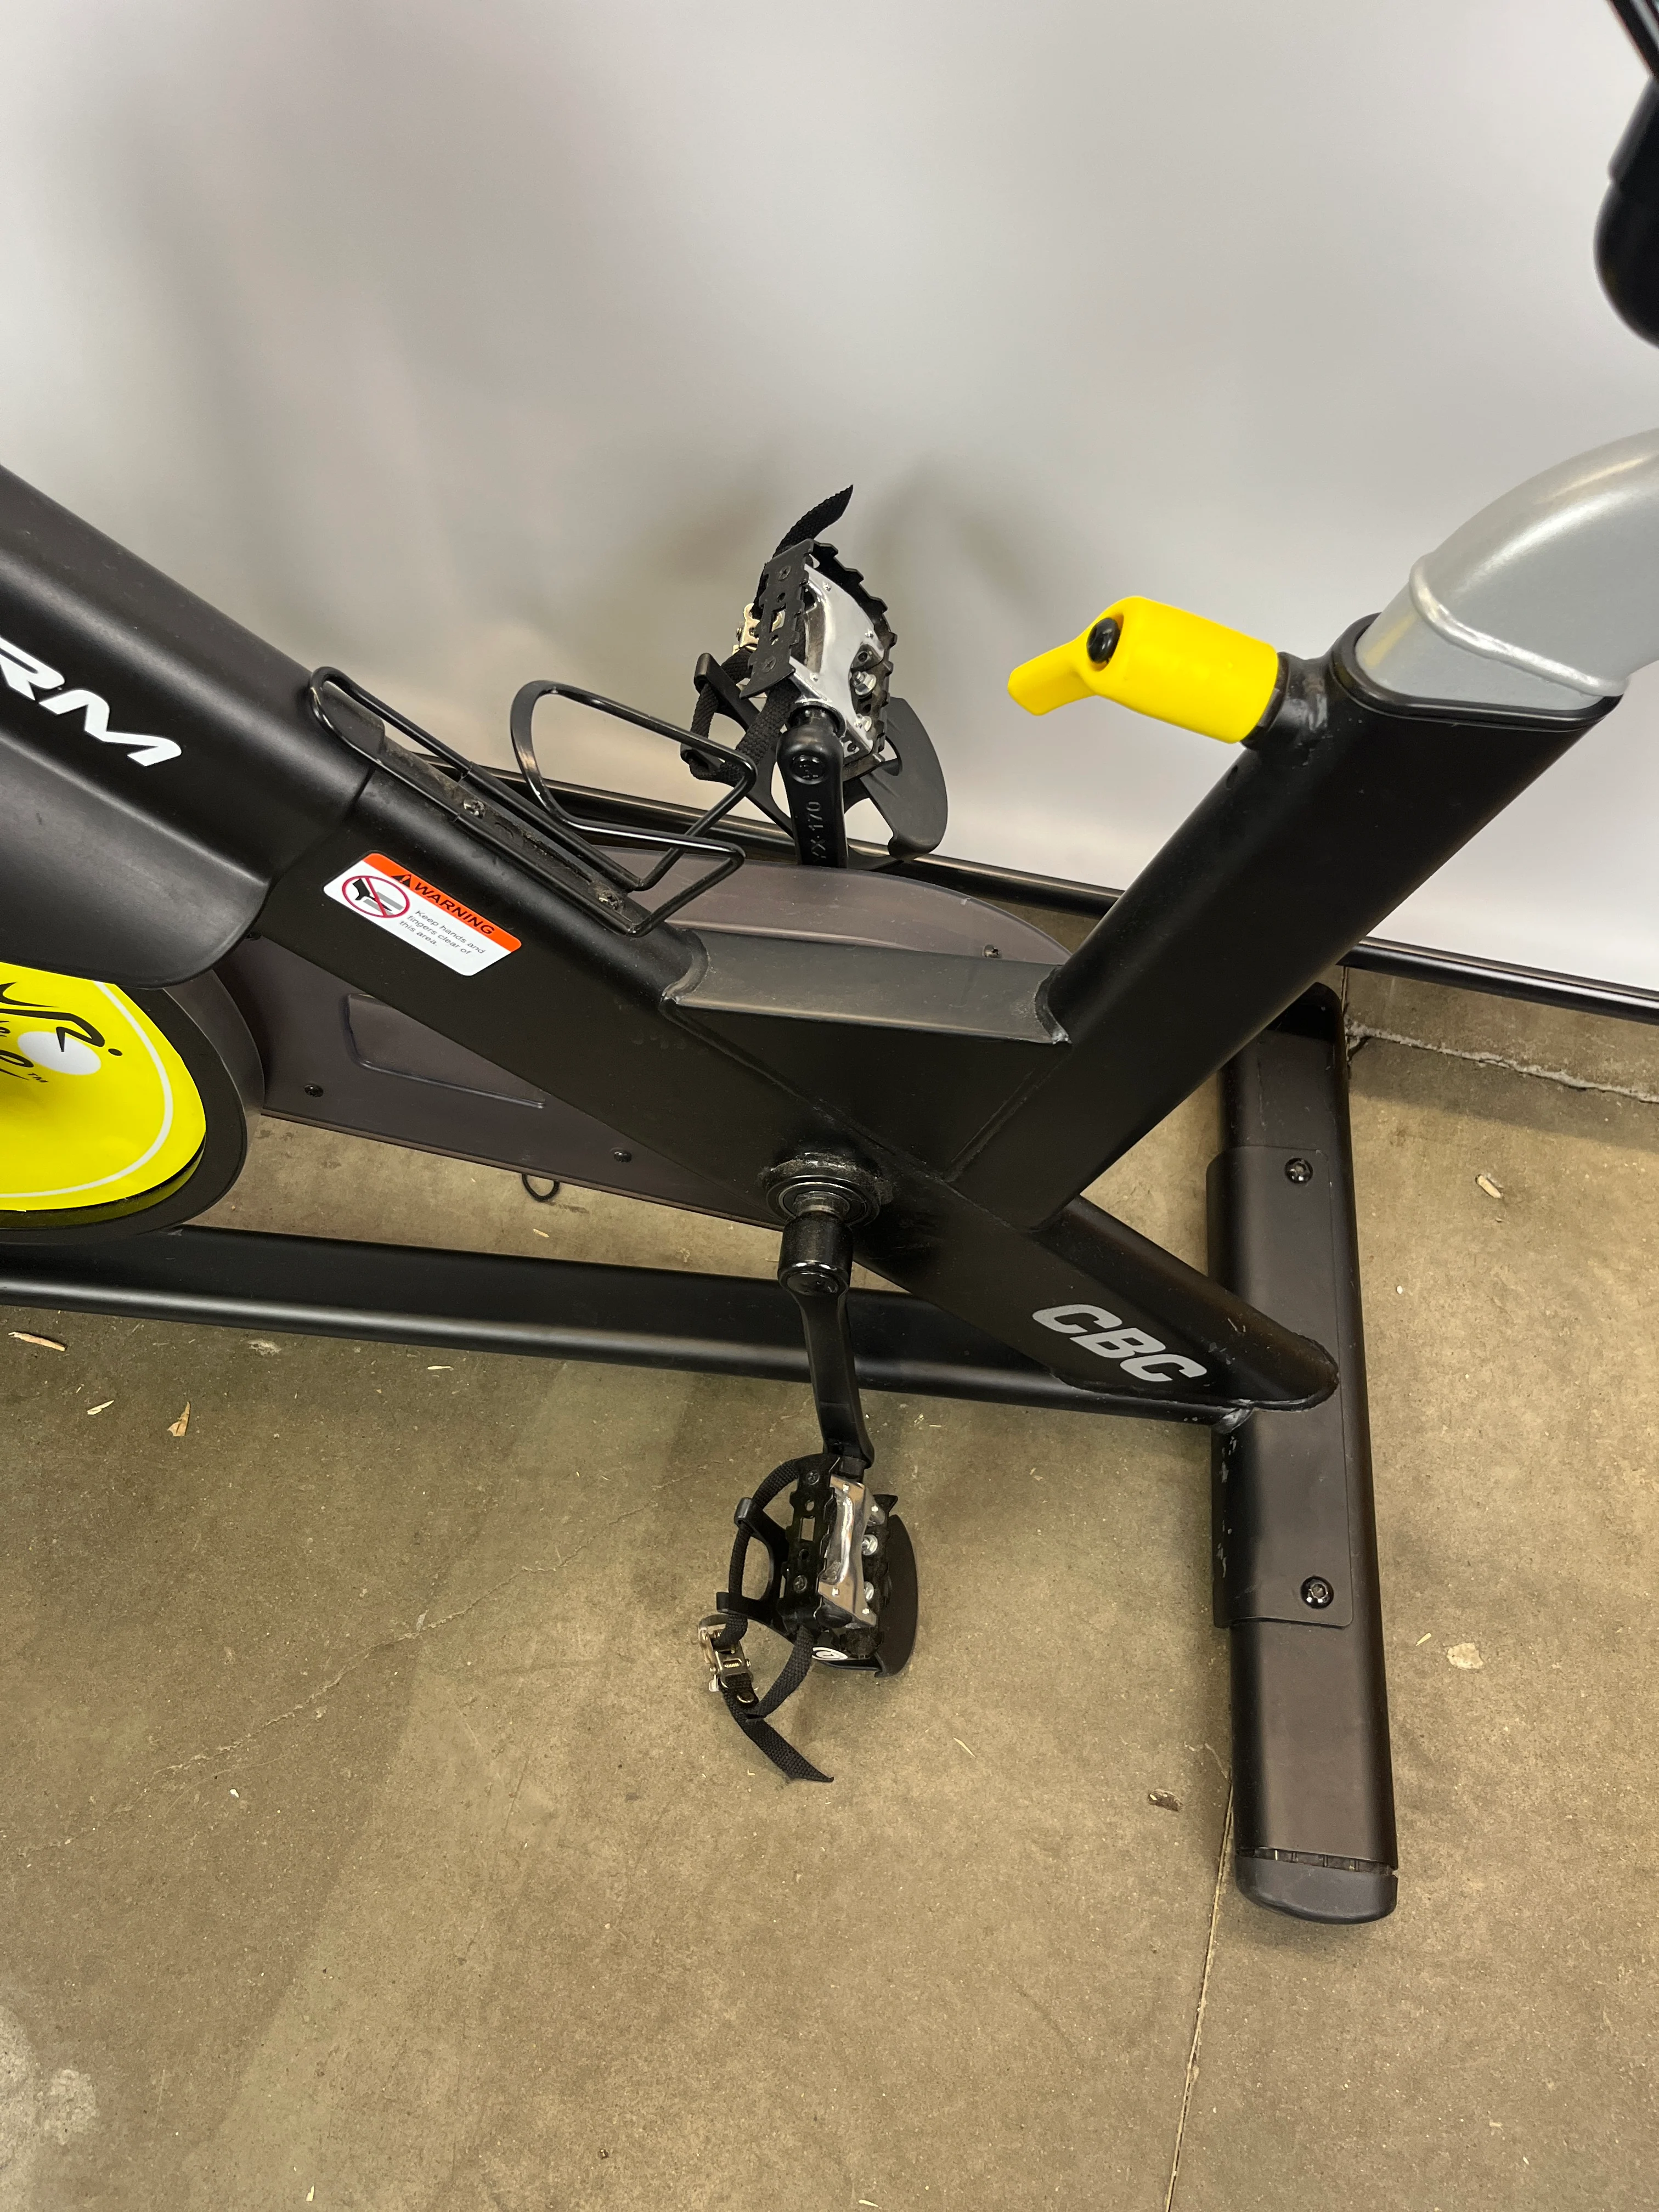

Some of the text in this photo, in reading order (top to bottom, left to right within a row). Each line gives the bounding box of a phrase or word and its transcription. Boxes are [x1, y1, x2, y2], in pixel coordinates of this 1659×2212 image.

[415, 882, 495, 934] WARNING
[399, 921, 438, 946] this area.
[407, 916, 437, 935] fingers
[438, 933, 461, 948] clear
[415, 910, 486, 954] Keep hands and
[1032, 1304, 1207, 1382] CBC
